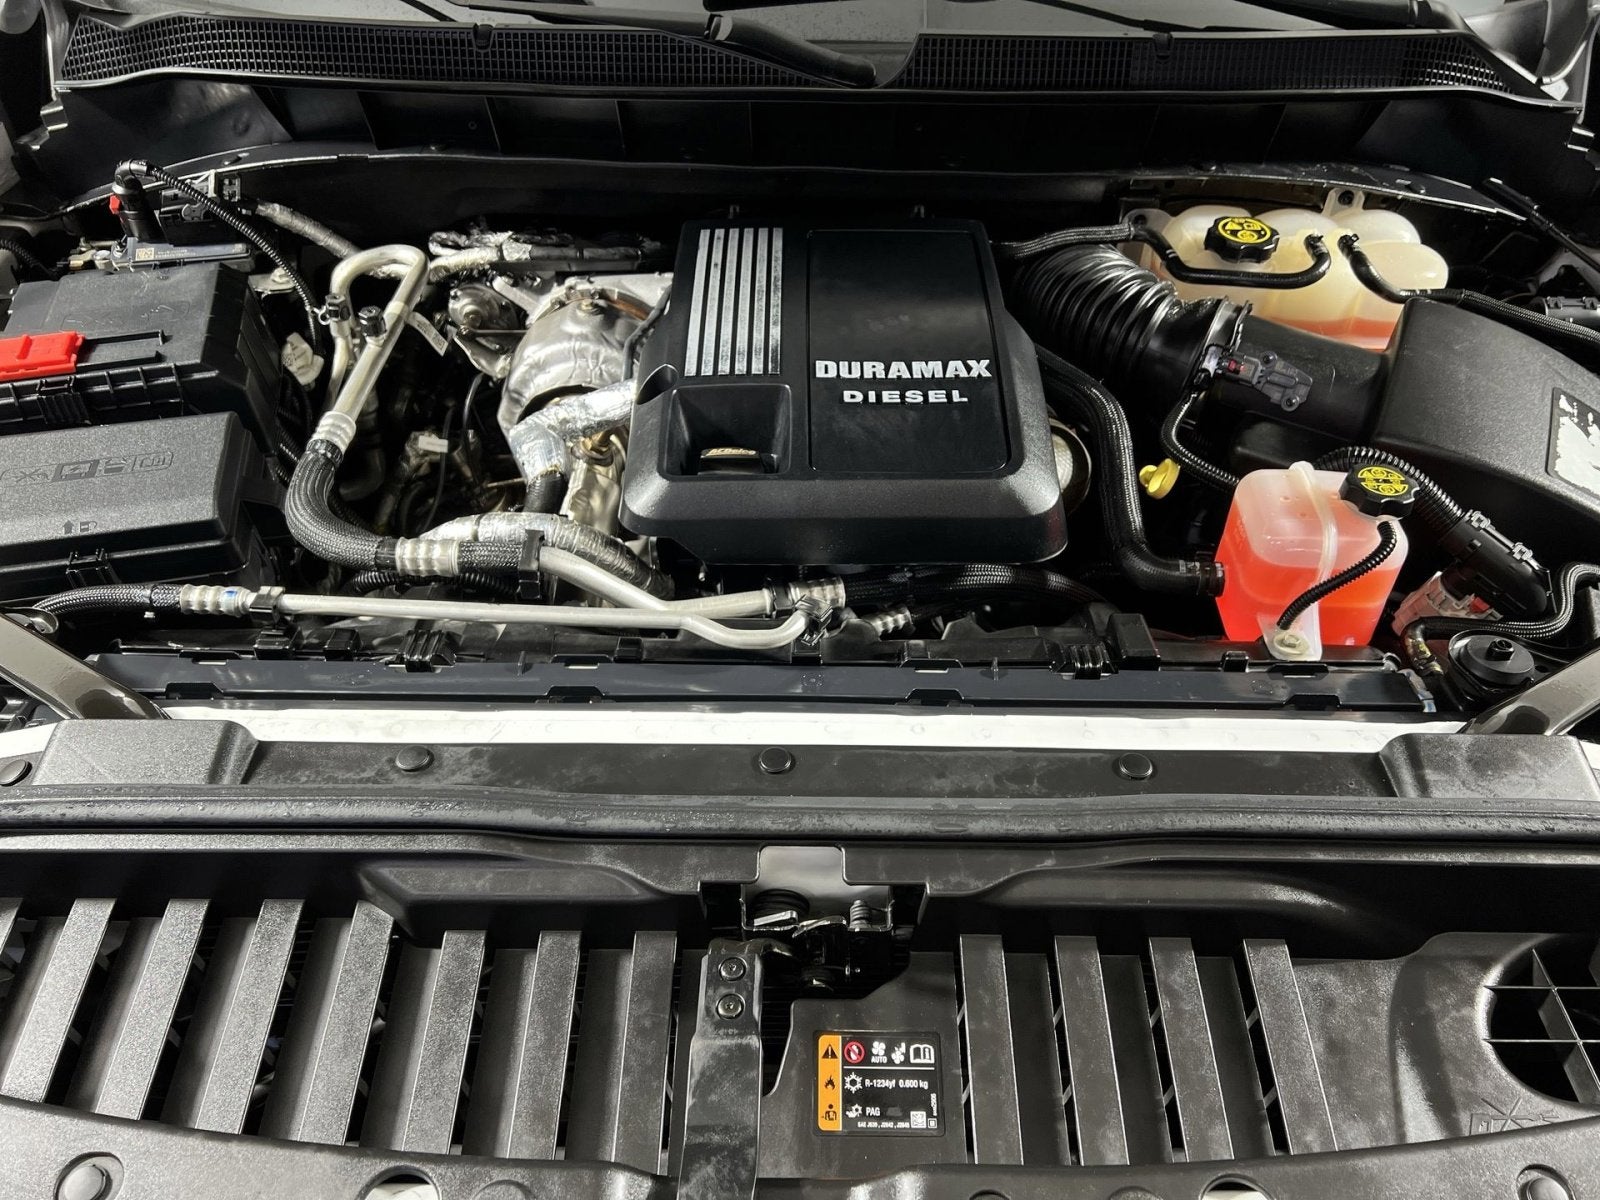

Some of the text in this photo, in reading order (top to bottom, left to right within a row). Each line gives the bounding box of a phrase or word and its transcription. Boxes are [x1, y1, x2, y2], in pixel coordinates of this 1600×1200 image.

[815, 359, 993, 379] DURAMAX
[843, 389, 969, 404] DIESEL
[871, 1055, 888, 1064] AUTO
[864, 1078, 929, 1090] R-1234yf 0.600 kg
[865, 1106, 880, 1117] PAG
